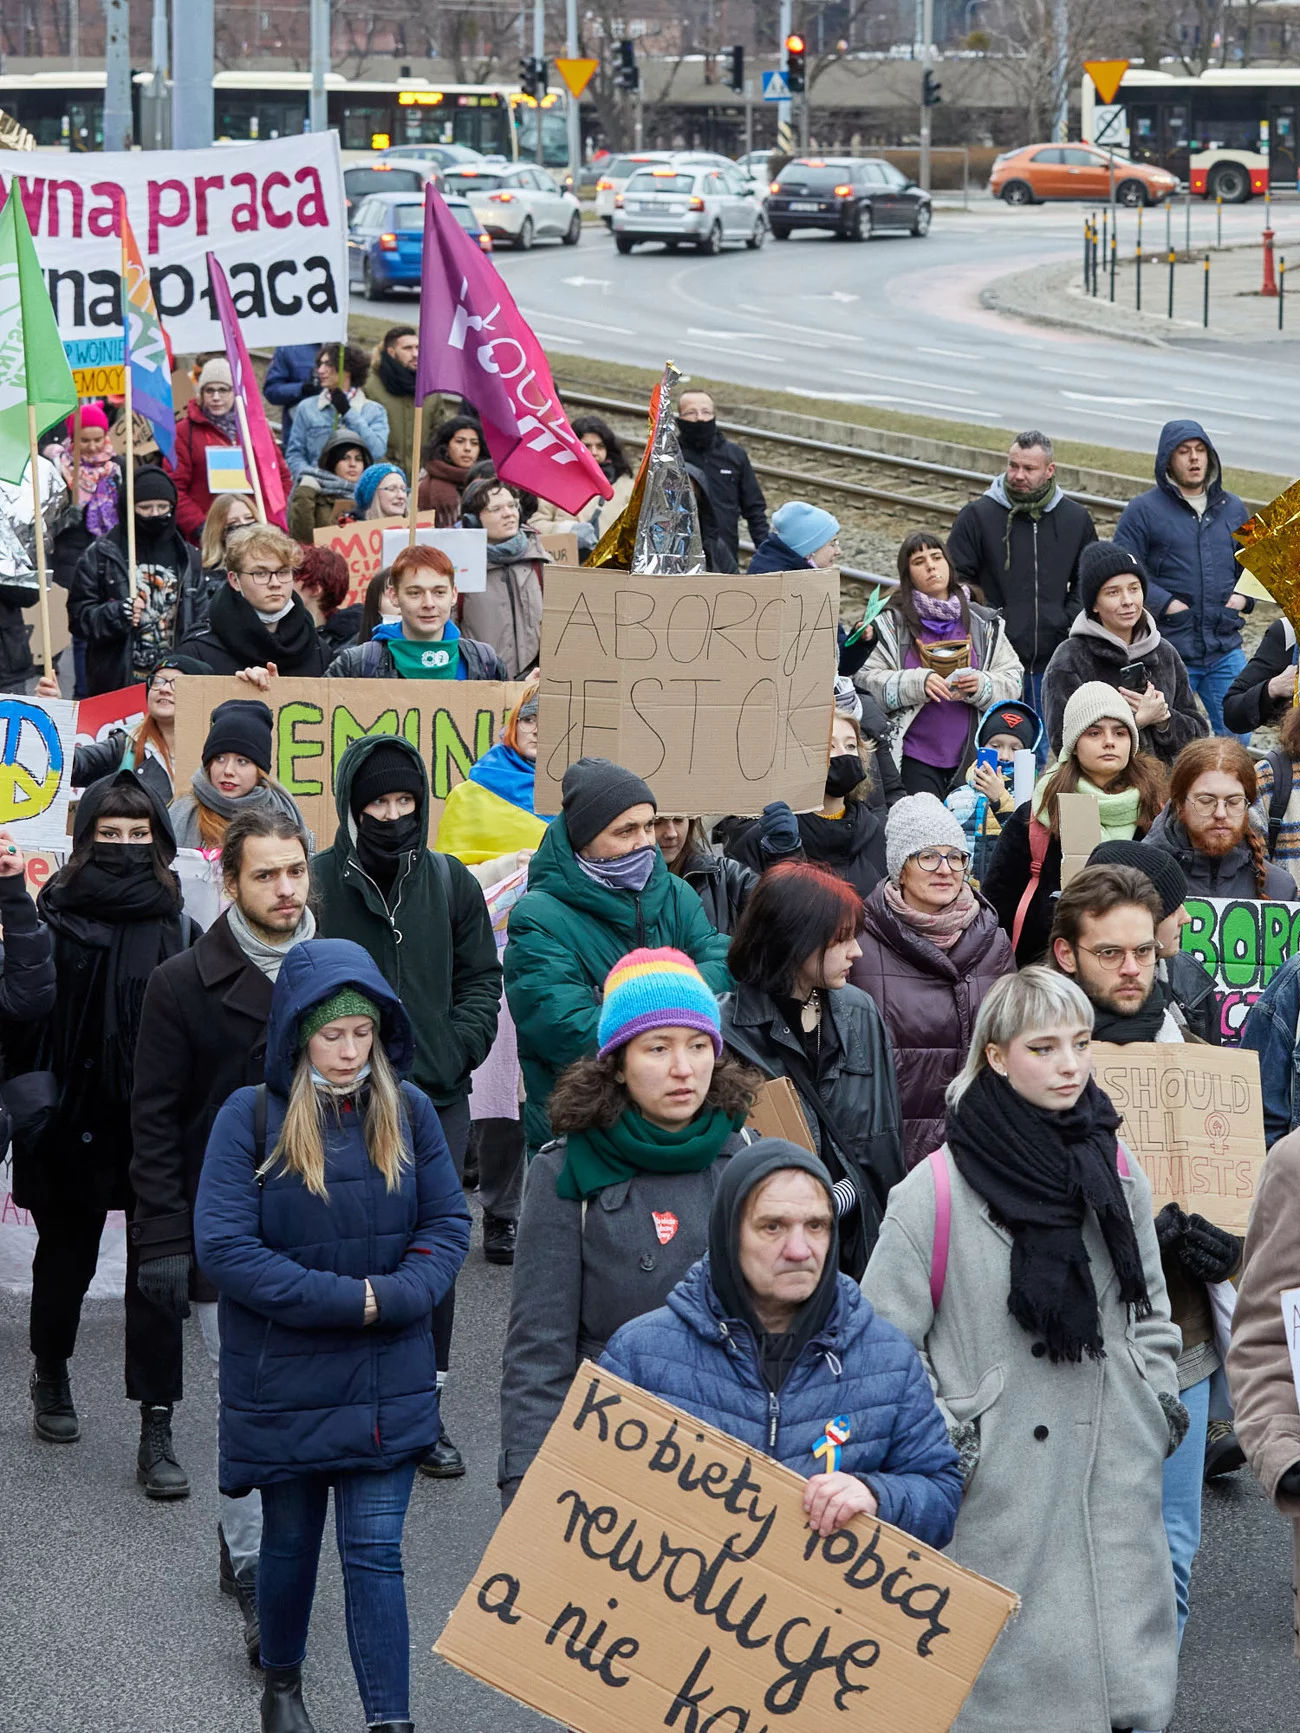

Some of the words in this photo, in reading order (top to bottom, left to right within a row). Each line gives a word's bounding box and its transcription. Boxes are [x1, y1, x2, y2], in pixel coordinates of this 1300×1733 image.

[147, 166, 329, 255] praca
[42, 268, 124, 328] na
[554, 590, 836, 677] ABORCJA
[546, 677, 722, 783] JEST
[736, 678, 819, 781] OK
[1104, 1067, 1251, 1115] SHOULD
[1117, 1111, 1189, 1152] ALL
[1137, 1156, 1254, 1199] INISTS
[573, 1378, 777, 1562] Kobiety
[803, 1522, 951, 1657] robią
[477, 1572, 522, 1625] a
[545, 1597, 640, 1688] nie
[558, 1489, 880, 1715] rewolucję
